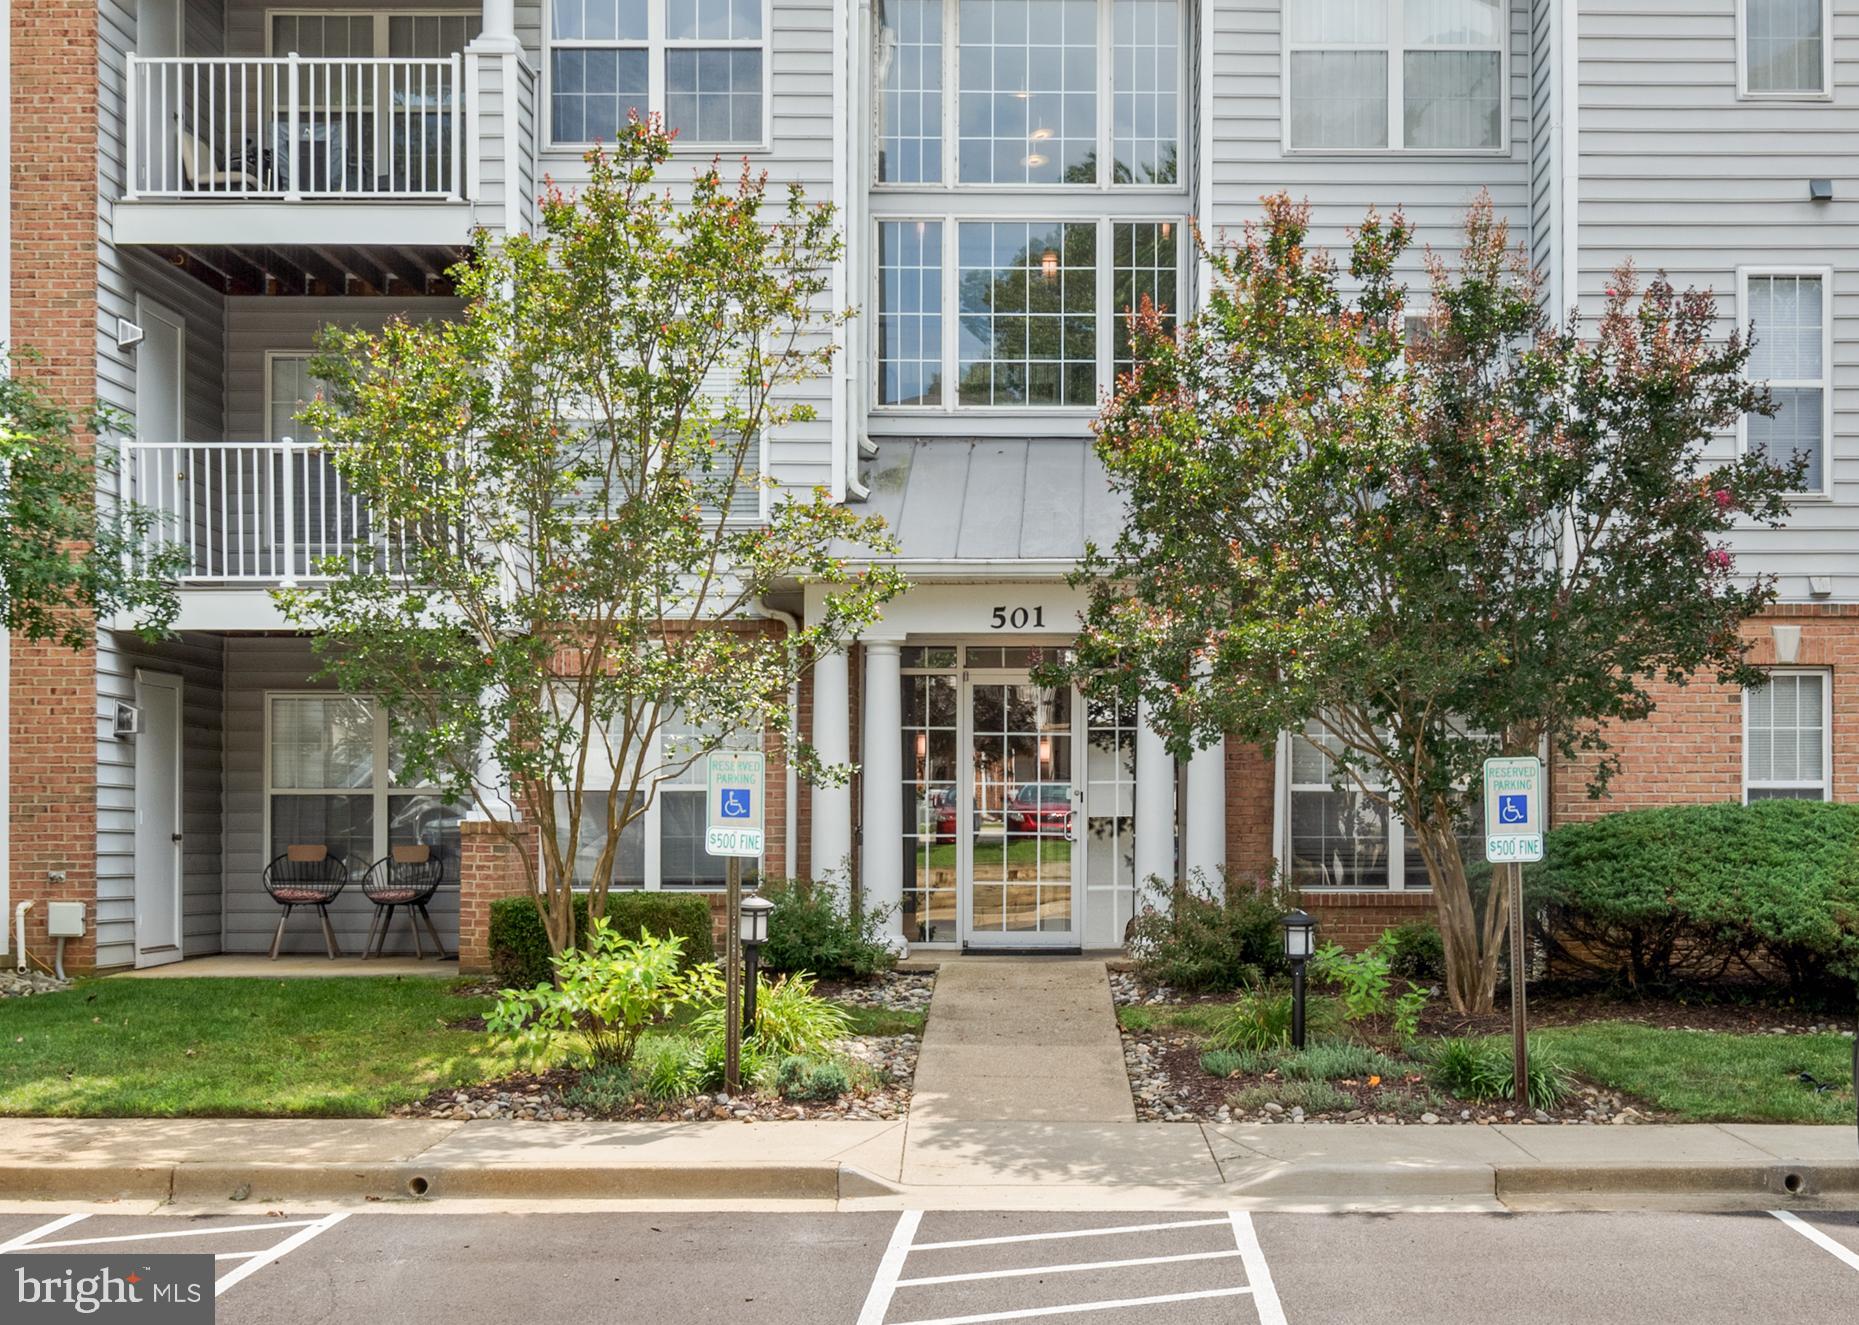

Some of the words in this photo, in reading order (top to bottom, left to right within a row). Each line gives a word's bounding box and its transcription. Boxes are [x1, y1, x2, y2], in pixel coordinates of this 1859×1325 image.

[990, 605, 1045, 629] 501
[716, 773, 756, 784] PARKING
[1489, 767, 1536, 778] RESERVED
[1493, 779, 1532, 791] PARKING
[710, 833, 736, 849] $500
[740, 834, 760, 850] FINE
[1490, 840, 1515, 855] $500
[1519, 839, 1539, 855] FINE
